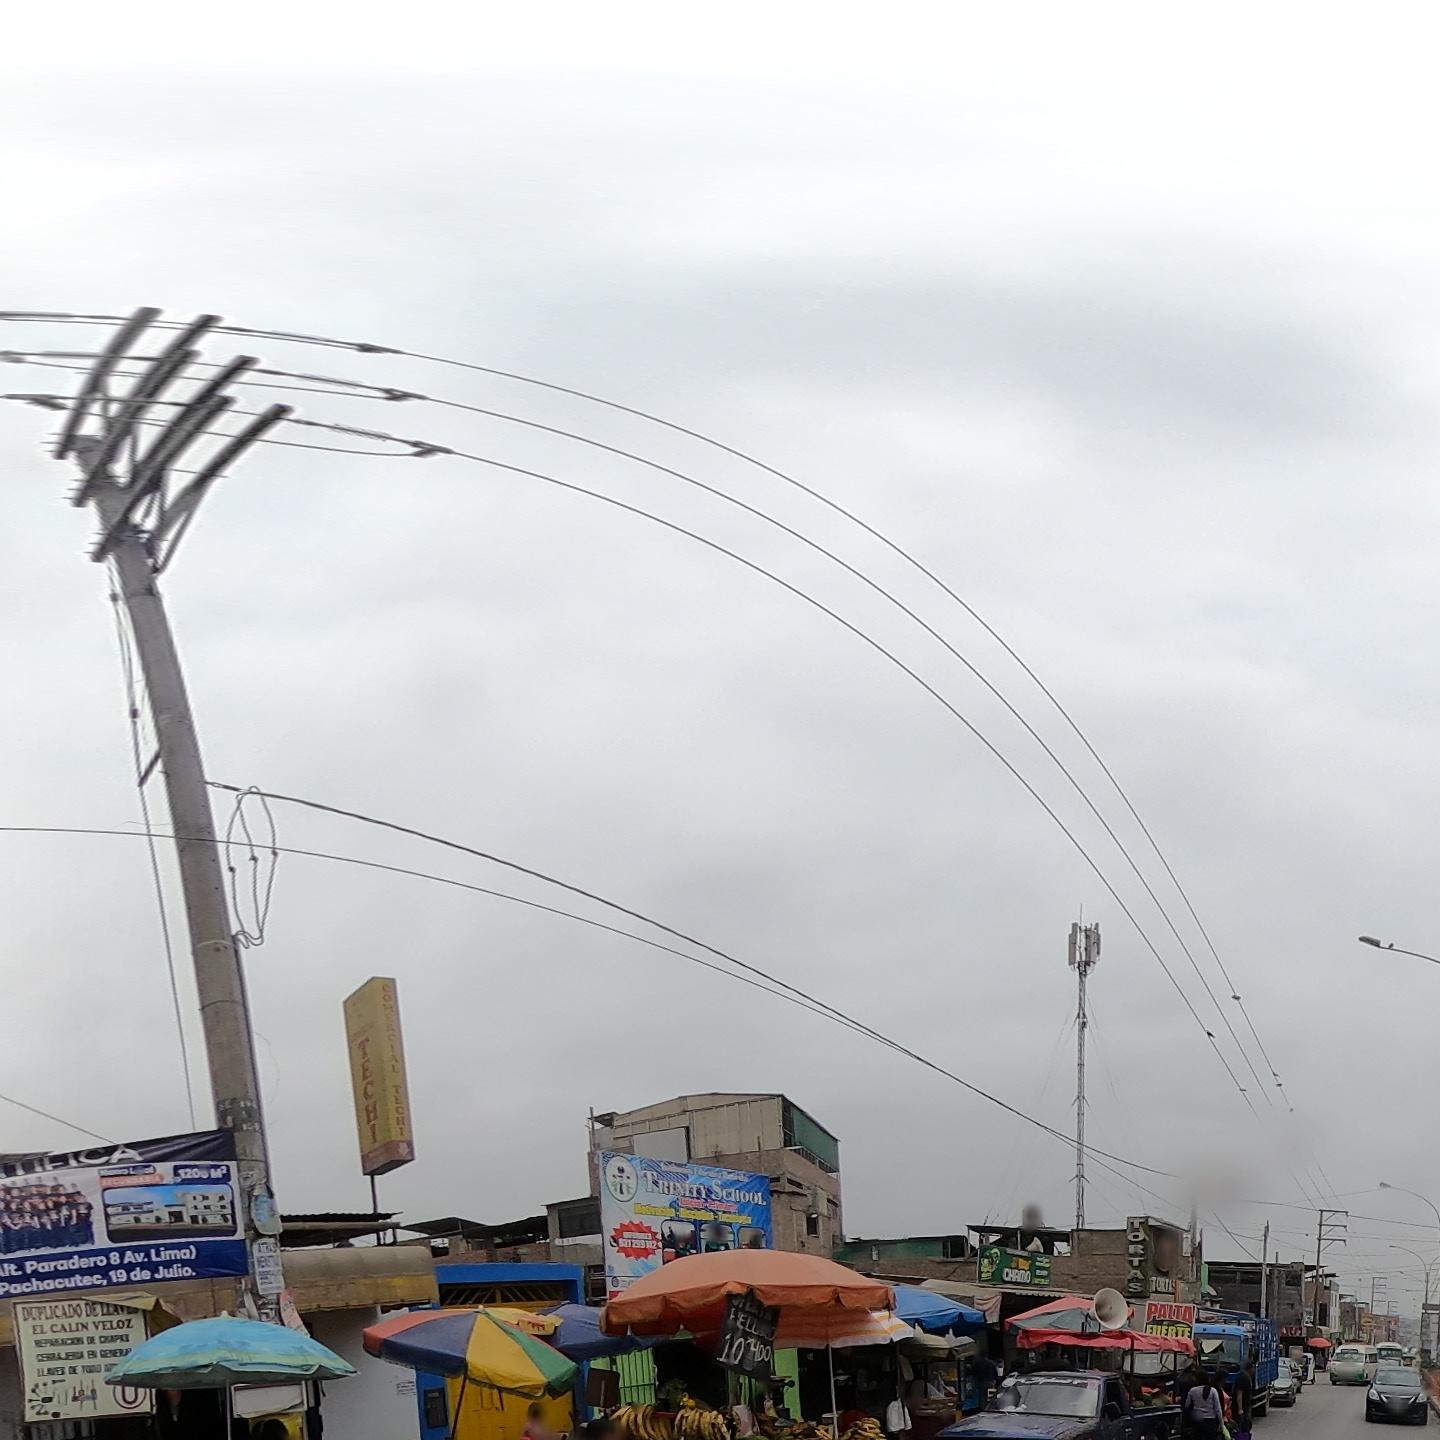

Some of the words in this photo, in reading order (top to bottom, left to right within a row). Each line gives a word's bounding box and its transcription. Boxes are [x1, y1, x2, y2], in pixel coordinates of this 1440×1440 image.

[641, 1170, 709, 1199] TRINITY
[711, 1180, 767, 1206] SCHOOL
[26, 1252, 107, 1275] Paradero
[109, 1251, 120, 1267] 8
[123, 1250, 149, 1265] Av.
[151, 1243, 197, 1262] Lima)
[1127, 1217, 1146, 1294] TORTAS
[109, 1269, 128, 1284] 19
[129, 1267, 152, 1283] de
[154, 1263, 197, 1282] Julio.
[22, 1304, 84, 1322] DUPLICADO
[84, 1303, 100, 1318] DE
[1146, 1302, 1195, 1324] PALTA
[32, 1323, 49, 1336] EL
[49, 1321, 89, 1335] CALIN
[90, 1318, 135, 1332] VELOZ
[86, 1335, 97, 1346] DE
